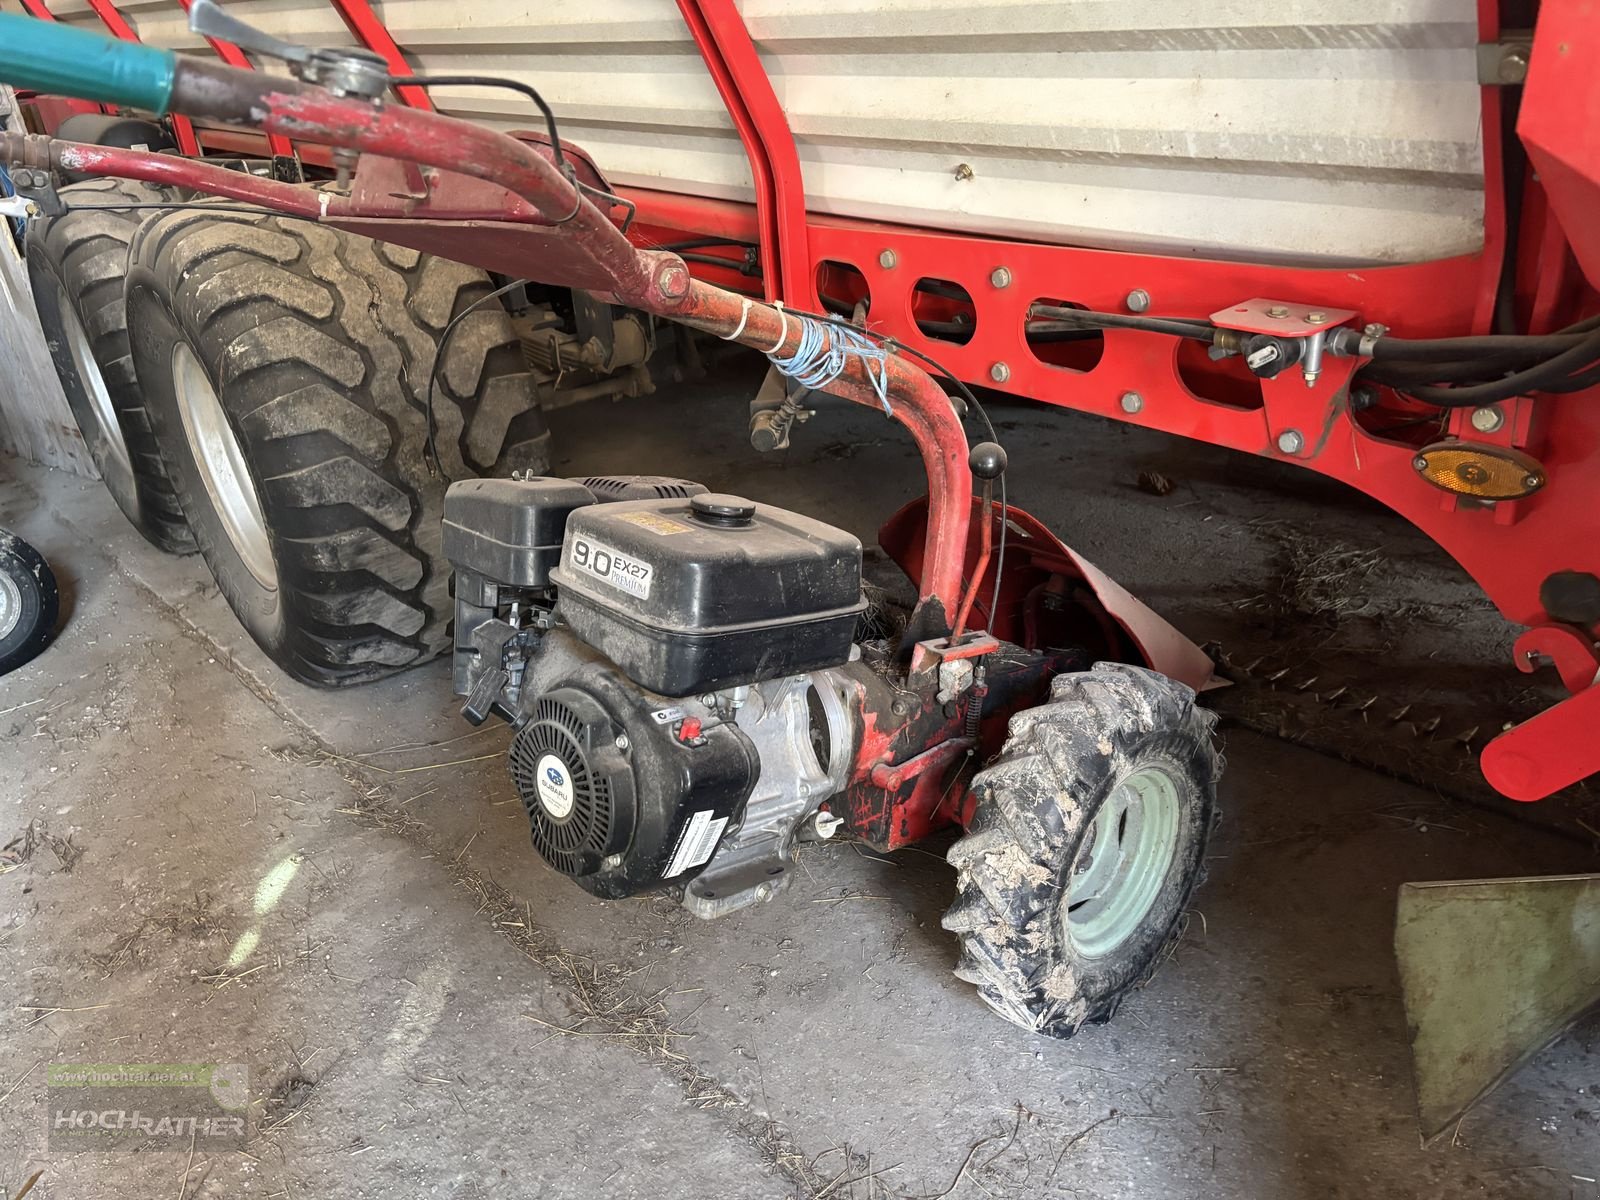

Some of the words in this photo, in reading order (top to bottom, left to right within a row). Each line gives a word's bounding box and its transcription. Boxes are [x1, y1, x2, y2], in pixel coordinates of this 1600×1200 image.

[573, 540, 612, 577] 9.0
[613, 557, 649, 580] EX27
[611, 570, 647, 596] PREMIUM
[541, 779, 568, 801] SUBARU
